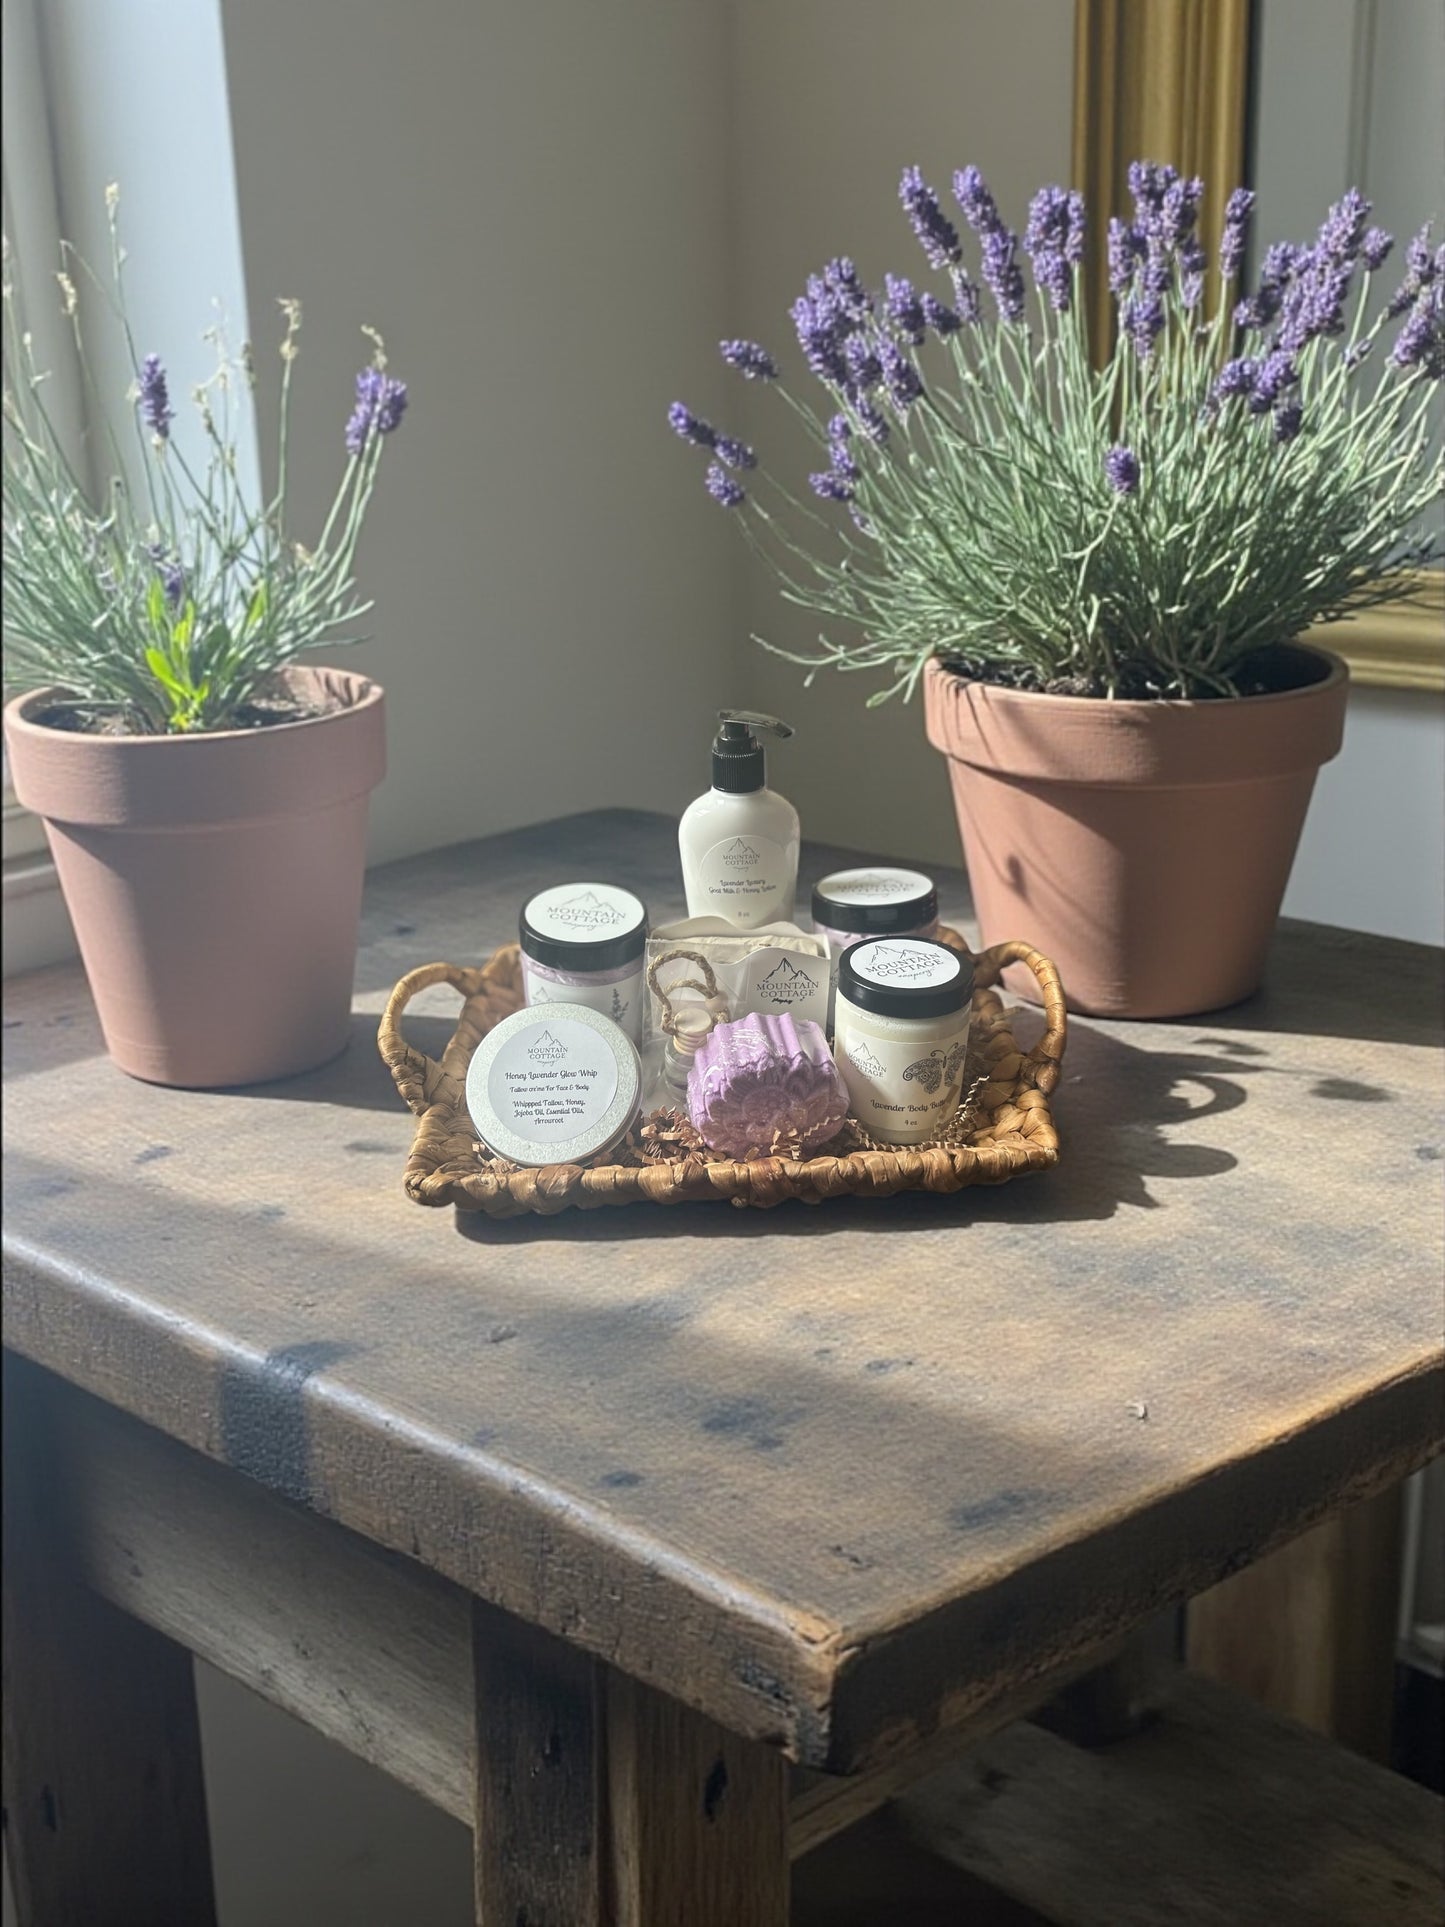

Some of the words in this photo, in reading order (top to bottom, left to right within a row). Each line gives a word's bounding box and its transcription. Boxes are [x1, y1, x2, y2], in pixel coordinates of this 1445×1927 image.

[546, 906, 626, 919] MOUNTAIN
[549, 914, 619, 925] COTTAGE
[864, 952, 941, 973] MOUNTAIN
[877, 958, 944, 977] COTTAGE
[756, 981, 819, 991] MOUNTAIN
[760, 989, 815, 998] COTTAGE
[527, 1047, 568, 1055] MOUNTAIN
[848, 1053, 887, 1073] MOUNTAIN
[849, 1060, 883, 1078] COTTAGE
[505, 1071, 527, 1081] Honey
[528, 1071, 559, 1080] Lavender
[559, 1069, 577, 1079] Glow
[579, 1069, 598, 1079] Whip
[870, 1099, 905, 1112] Lavender
[907, 1103, 928, 1112] Body
[513, 1109, 533, 1118] Jojoba
[546, 1107, 570, 1115] Essential
[533, 1117, 564, 1125] Arrowroot
